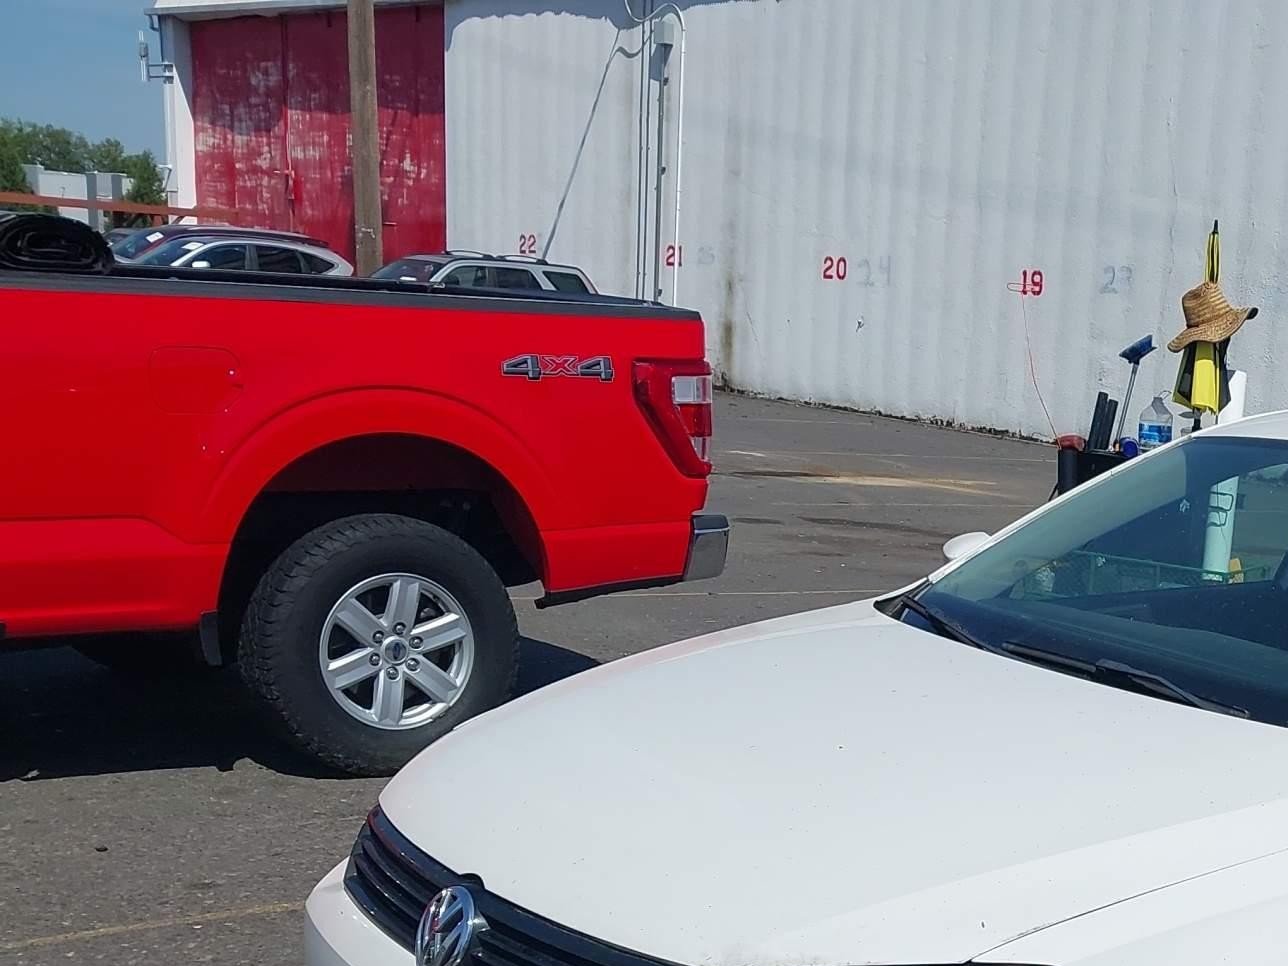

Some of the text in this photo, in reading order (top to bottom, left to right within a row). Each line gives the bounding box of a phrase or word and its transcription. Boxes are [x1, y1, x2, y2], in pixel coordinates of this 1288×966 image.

[519, 234, 537, 254] 22
[666, 245, 683, 267] 21
[823, 256, 847, 280] 20
[1021, 269, 1043, 296] 19
